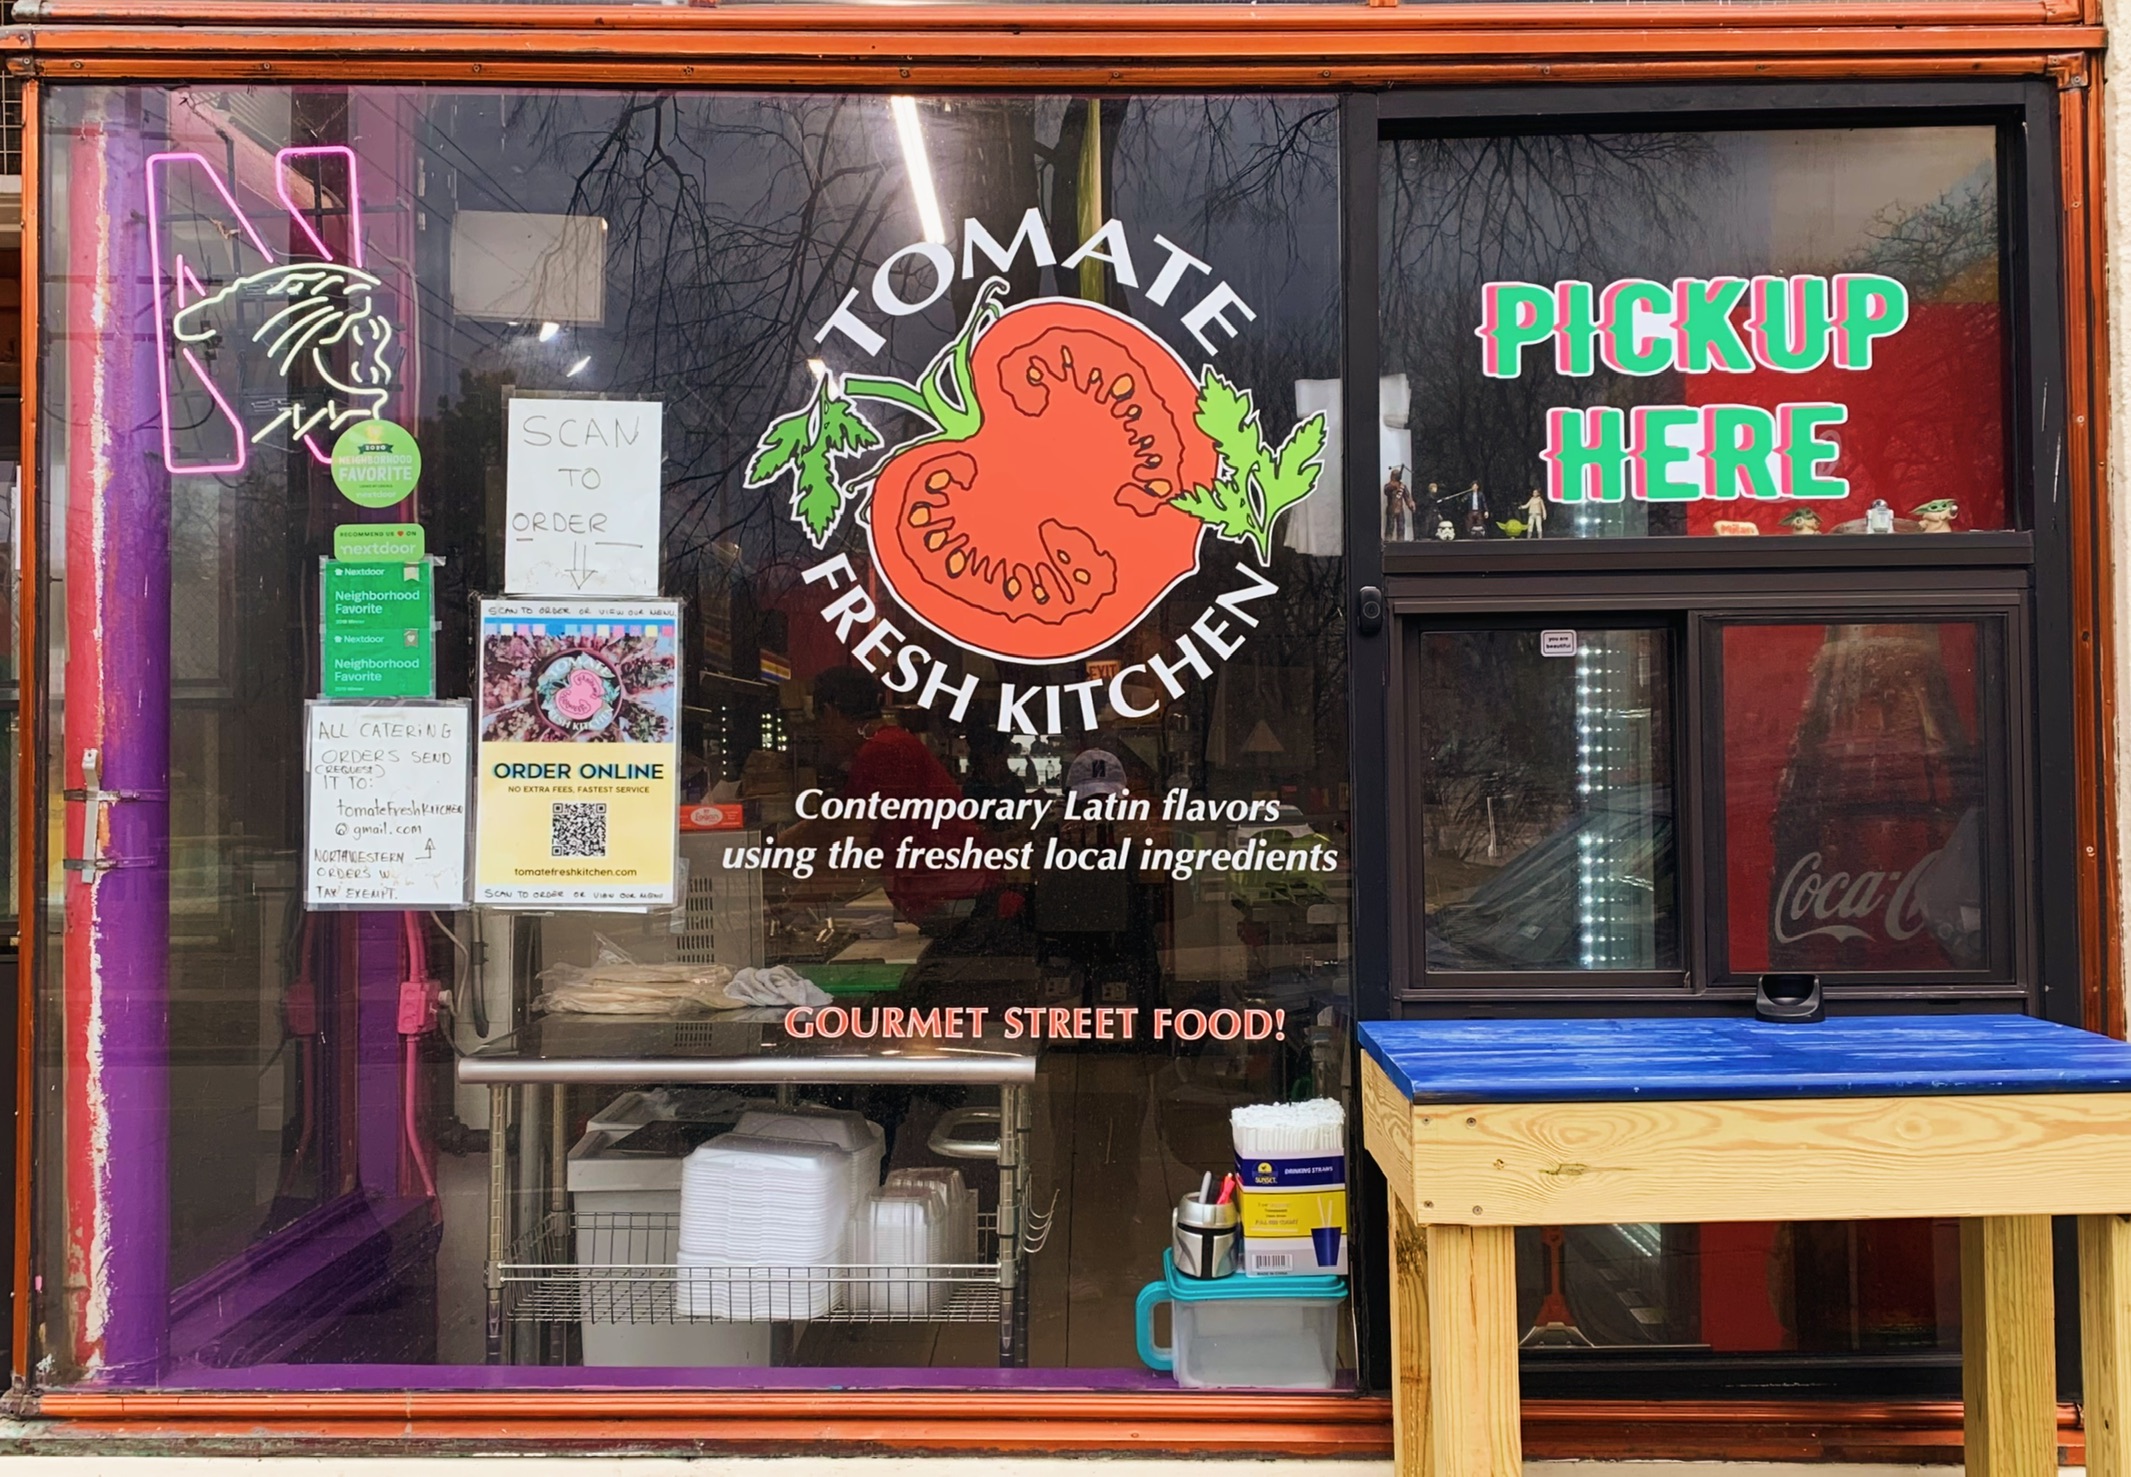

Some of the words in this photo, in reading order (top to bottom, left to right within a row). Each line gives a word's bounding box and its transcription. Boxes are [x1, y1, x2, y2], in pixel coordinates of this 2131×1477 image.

[813, 207, 1257, 356] TOMATE
[1475, 273, 1909, 379] PICKUP
[522, 414, 641, 449] SCAN
[338, 454, 413, 465] NEIGHBORHOOD
[1539, 402, 1850, 504] HERE
[338, 466, 413, 482] FAVORITE
[558, 467, 602, 491] TO
[512, 511, 608, 534] ORDER
[339, 541, 417, 555] nextdoor
[344, 567, 386, 576] Nextdoor
[335, 590, 420, 603] Neighborhood
[335, 603, 383, 614] Favorite
[488, 607, 518, 615] SCAN
[521, 606, 534, 615] TO
[539, 607, 571, 616] ORDER
[599, 608, 624, 617] VIEW
[628, 609, 645, 617] OUR
[344, 635, 385, 643] Nextdoor
[801, 552, 981, 722] FRESH
[997, 561, 1280, 735] KITCHEN
[335, 658, 420, 671] Neighborhood
[334, 671, 383, 682] Favorite
[319, 721, 349, 740] ALL
[321, 749, 400, 765] ORDERS
[411, 750, 452, 765] SEND
[493, 762, 572, 780] ORDER
[579, 762, 665, 780] ONLINE
[323, 775, 338, 790] IT
[350, 775, 373, 790] TO:
[508, 785, 522, 793] NO
[524, 785, 550, 793] EXTRA
[552, 785, 575, 794] FEES,
[577, 786, 614, 794] FASTEST
[615, 786, 650, 794] SERVICE
[793, 788, 1053, 831] Contemporary
[1064, 789, 1151, 822] Latin
[1161, 788, 1281, 822] flavors
[721, 838, 816, 880] using
[828, 837, 884, 871] the
[895, 837, 1032, 871] freshest
[1043, 838, 1130, 871] local
[1139, 839, 1340, 881] ingredients
[316, 867, 371, 879] ORDERS
[514, 867, 638, 877] tomatefreshkitchen.com
[316, 885, 338, 899] TAX
[484, 888, 513, 899] SCAN
[517, 890, 529, 899] TO
[532, 890, 565, 899] ORDER
[783, 1007, 989, 1041] GOURMET
[1003, 1007, 1139, 1041] STREET
[1153, 1007, 1287, 1042] FOOD!
[1284, 1167, 1311, 1175] DRINKING
[1311, 1166, 1334, 1174] STRAWS
